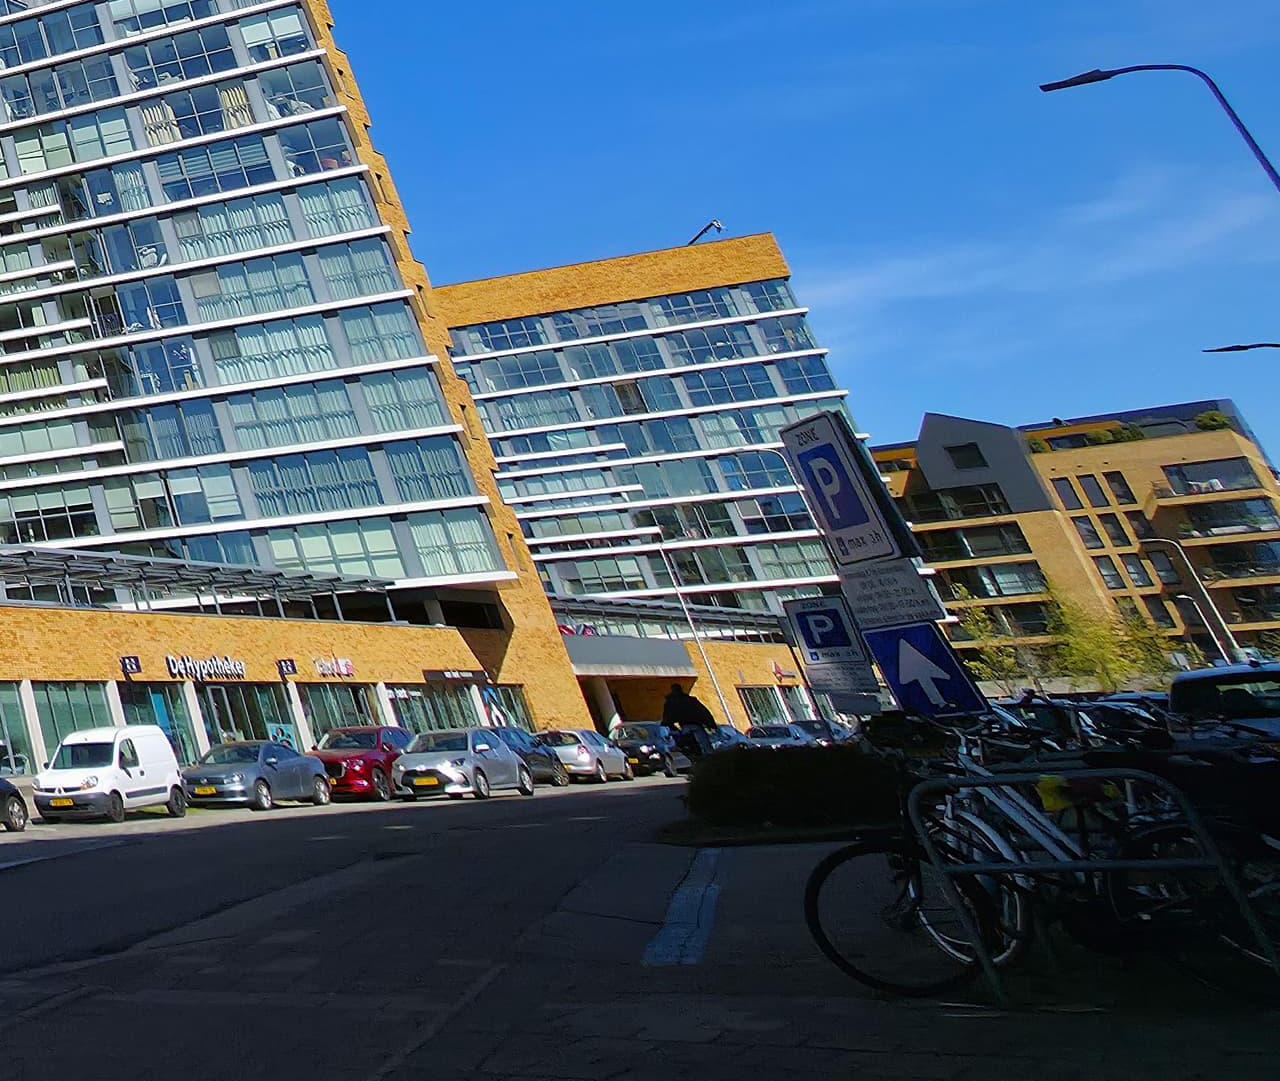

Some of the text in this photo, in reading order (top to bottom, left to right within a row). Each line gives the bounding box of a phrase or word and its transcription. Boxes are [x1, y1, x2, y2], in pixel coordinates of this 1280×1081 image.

[795, 427, 820, 447] ZONE
[807, 457, 840, 520] P
[806, 614, 834, 645] P
